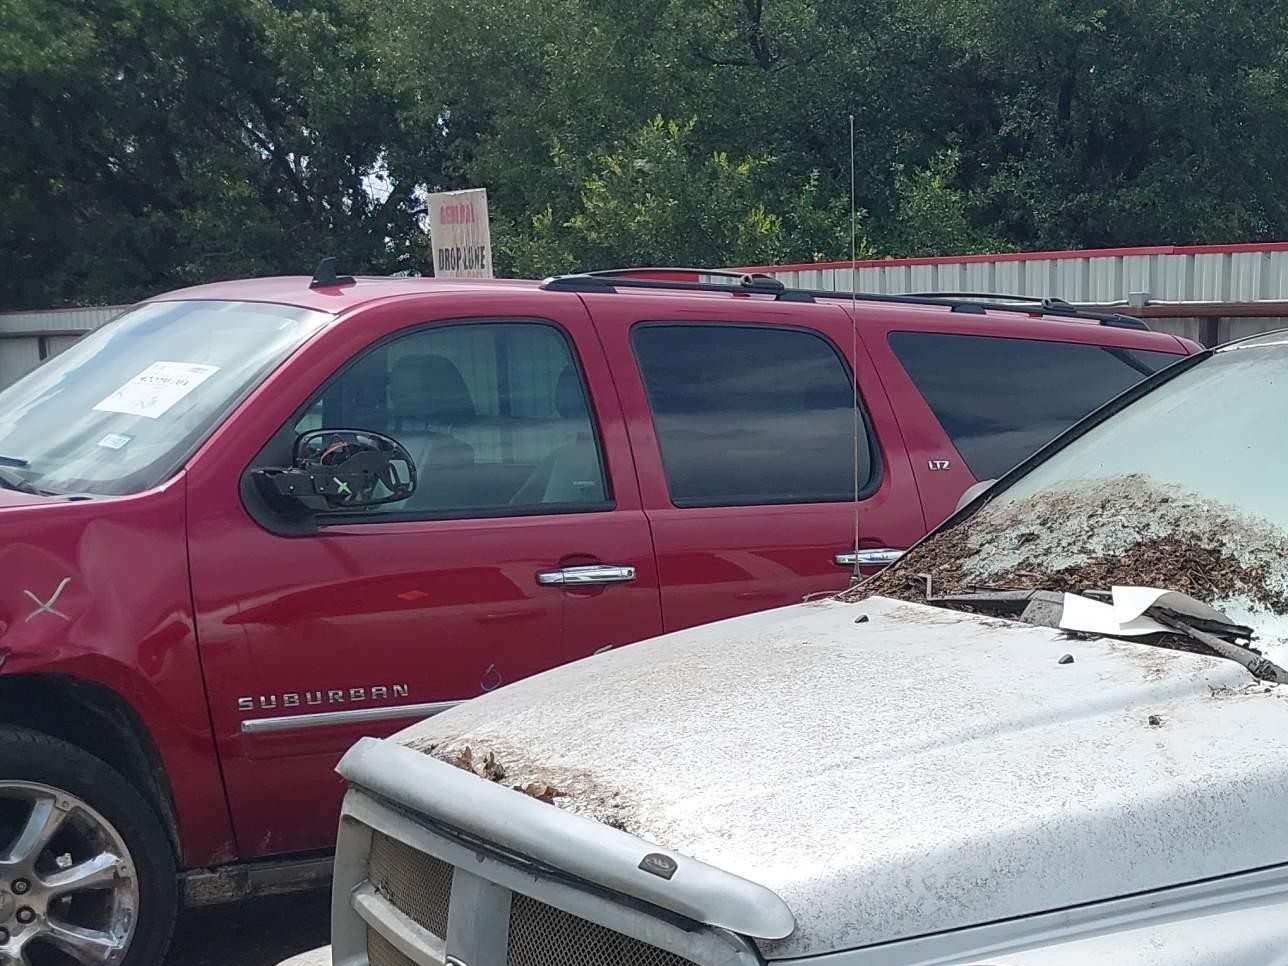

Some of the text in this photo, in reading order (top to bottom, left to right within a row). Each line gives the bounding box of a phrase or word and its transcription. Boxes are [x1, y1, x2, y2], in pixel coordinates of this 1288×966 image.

[438, 247, 460, 271] DROP
[928, 460, 951, 470] LTZ
[237, 683, 409, 711] SUBURBAN
